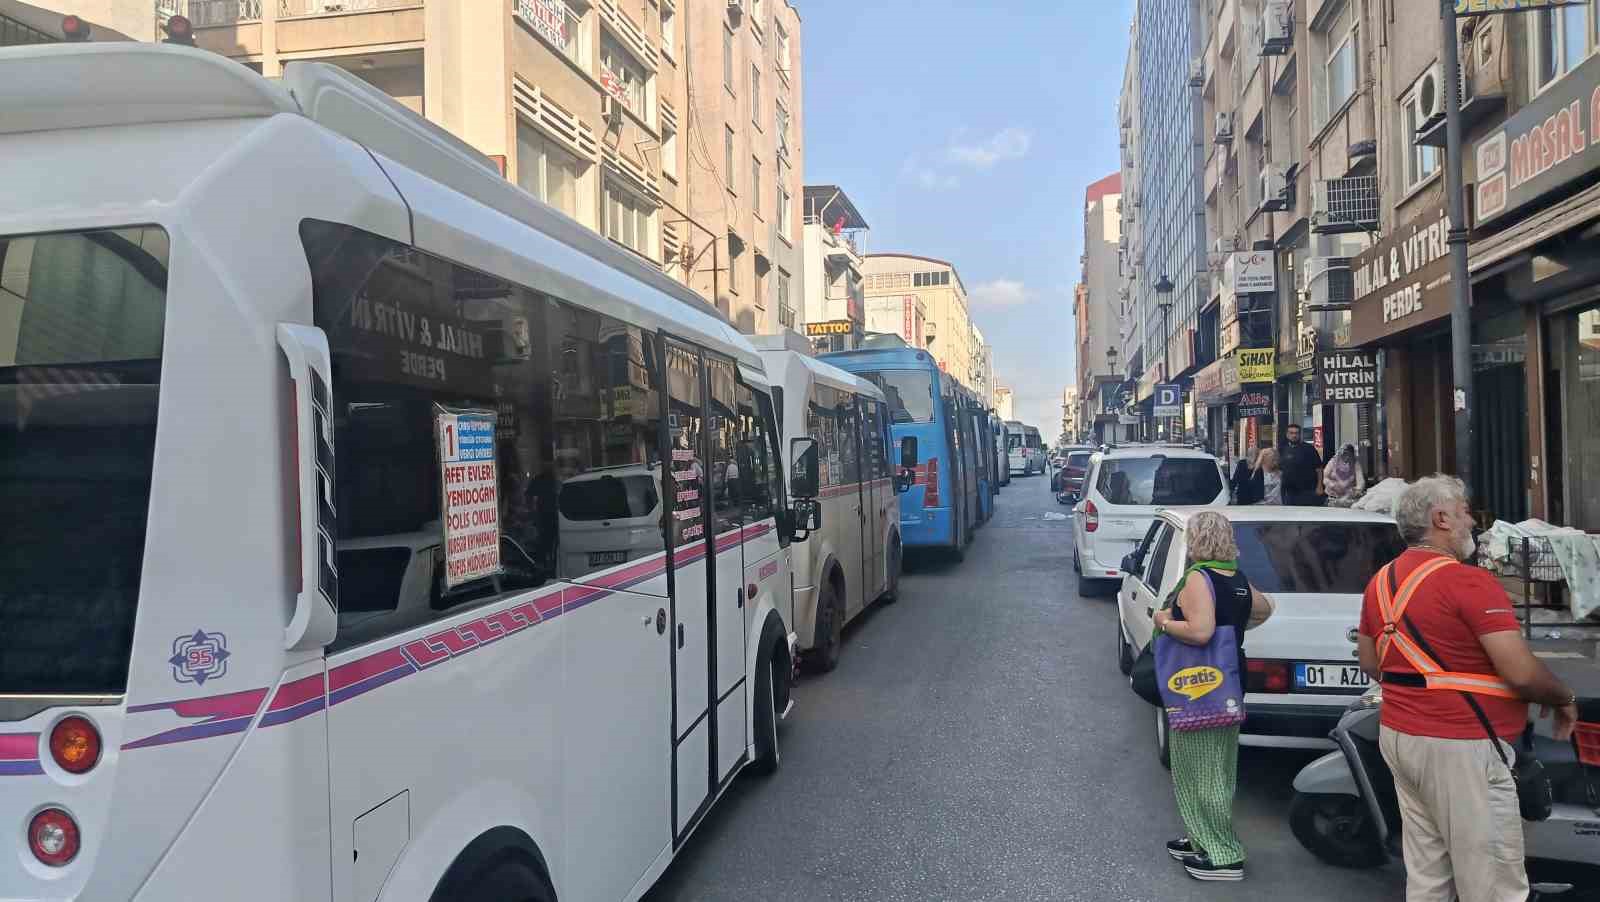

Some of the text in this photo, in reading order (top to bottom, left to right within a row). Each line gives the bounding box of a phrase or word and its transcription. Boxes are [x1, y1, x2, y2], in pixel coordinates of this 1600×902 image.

[1510, 99, 1584, 190] MASAL
[1353, 256, 1388, 301] HİLAL
[1390, 247, 1400, 282] &
[1383, 281, 1423, 323] PERDE
[809, 323, 849, 334] TATTOO
[1323, 353, 1374, 369] HİLAL
[1323, 369, 1375, 385] VİTRİN
[1161, 389, 1175, 405] D
[1325, 386, 1375, 400] PERDE
[446, 424, 454, 457] 1
[472, 507, 497, 526] OKULU
[190, 649, 212, 666] 95
[1173, 668, 1217, 690] gratis
[1306, 665, 1325, 685] 01
